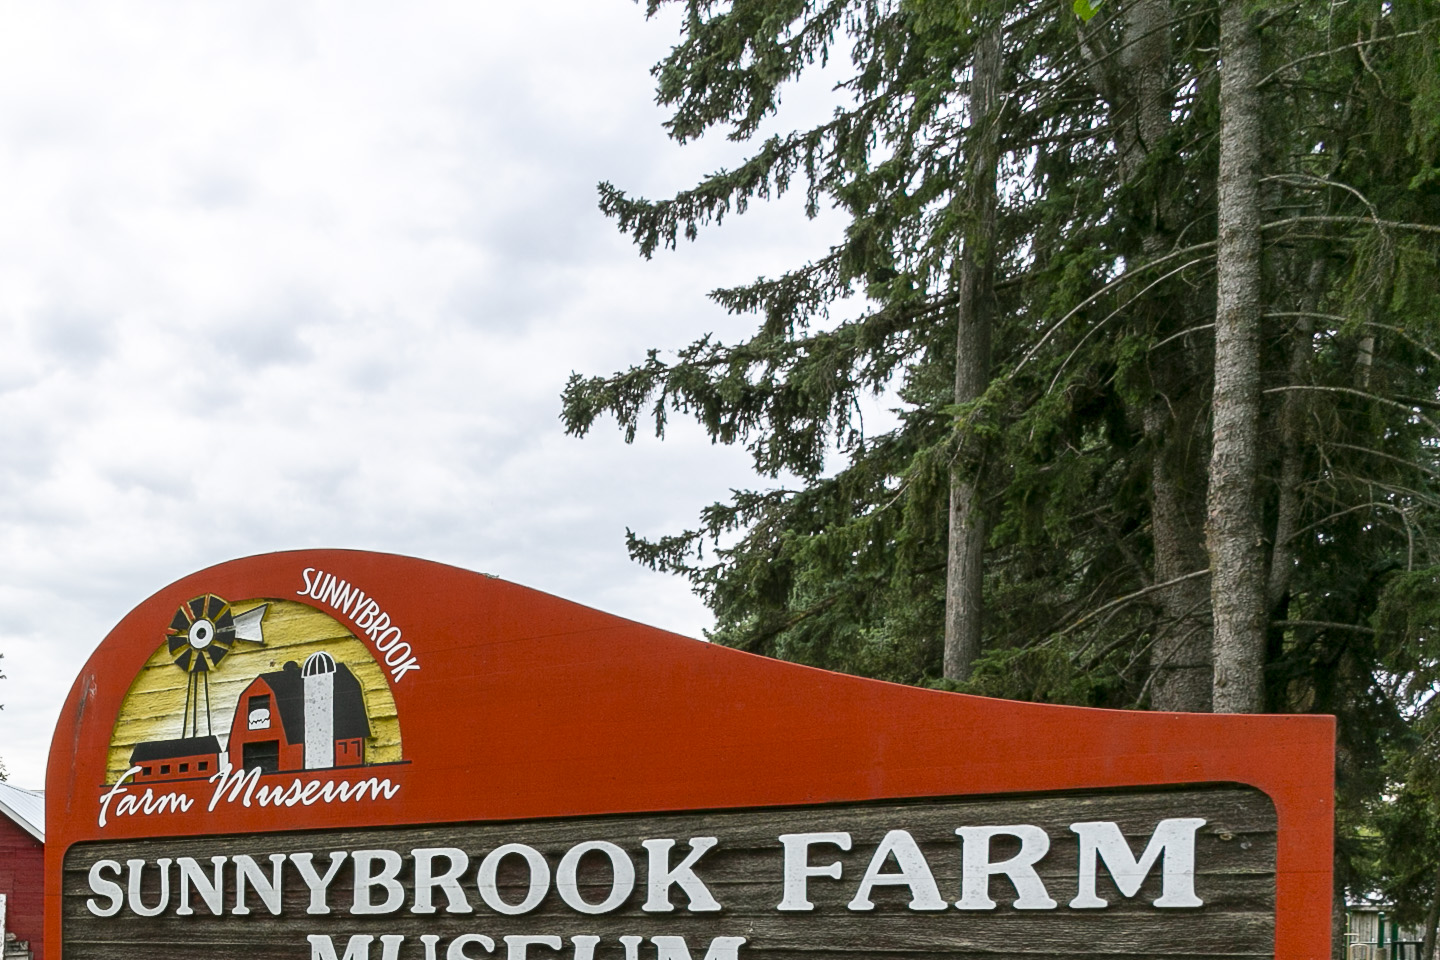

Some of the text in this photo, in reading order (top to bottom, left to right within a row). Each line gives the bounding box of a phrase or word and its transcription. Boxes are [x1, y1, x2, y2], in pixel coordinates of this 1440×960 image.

[296, 567, 420, 683] SUNNYBROOK
[208, 761, 401, 813] Museum
[86, 817, 1207, 918] SUNNYBROOK FARM
